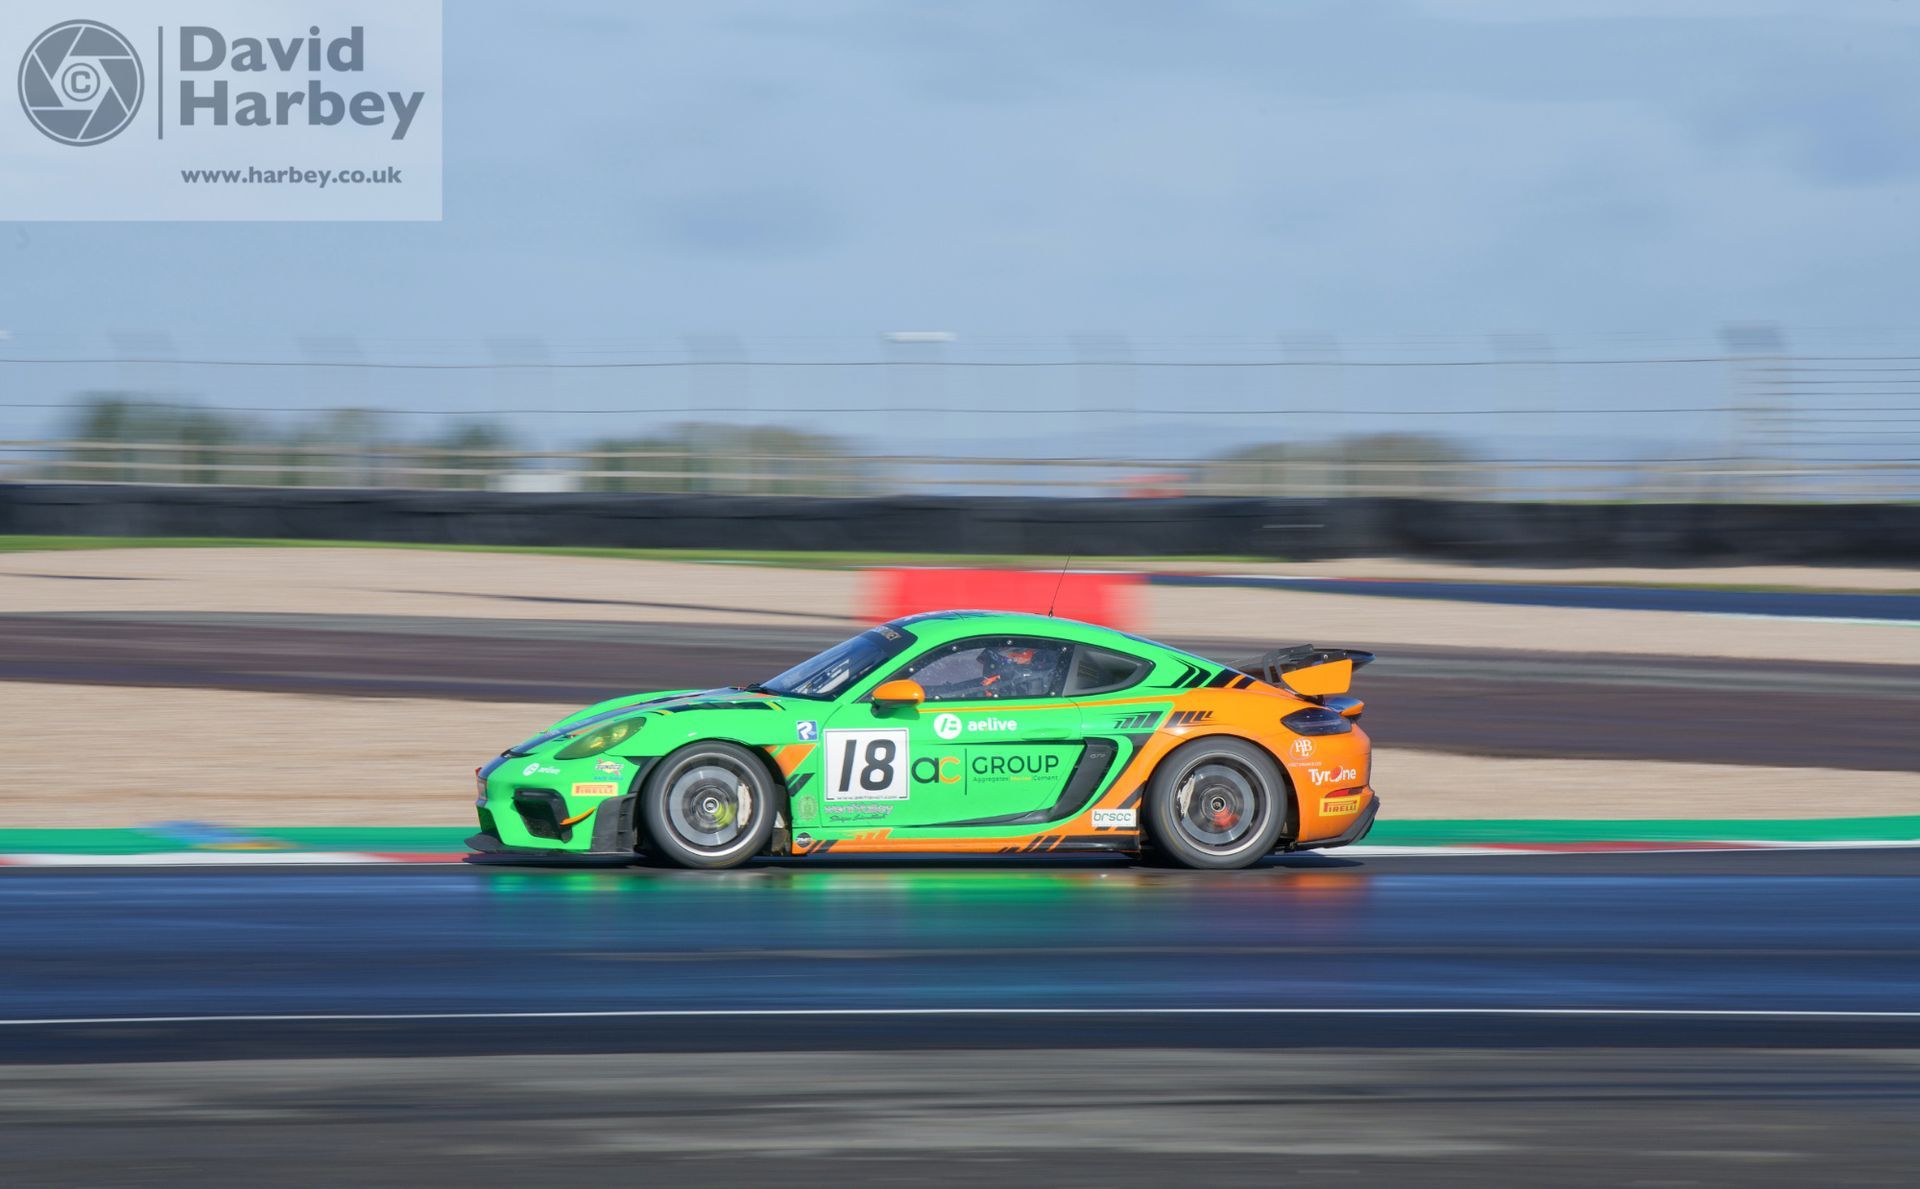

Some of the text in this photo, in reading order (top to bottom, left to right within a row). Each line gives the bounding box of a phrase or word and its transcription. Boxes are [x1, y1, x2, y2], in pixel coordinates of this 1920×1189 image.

[967, 717, 1018, 732] aelive
[838, 739, 897, 792] 18
[972, 755, 1059, 775] GROUP
[575, 784, 614, 794] PIRELLI
[1323, 800, 1357, 813] PIRELLI
[1093, 811, 1131, 822] brscc
